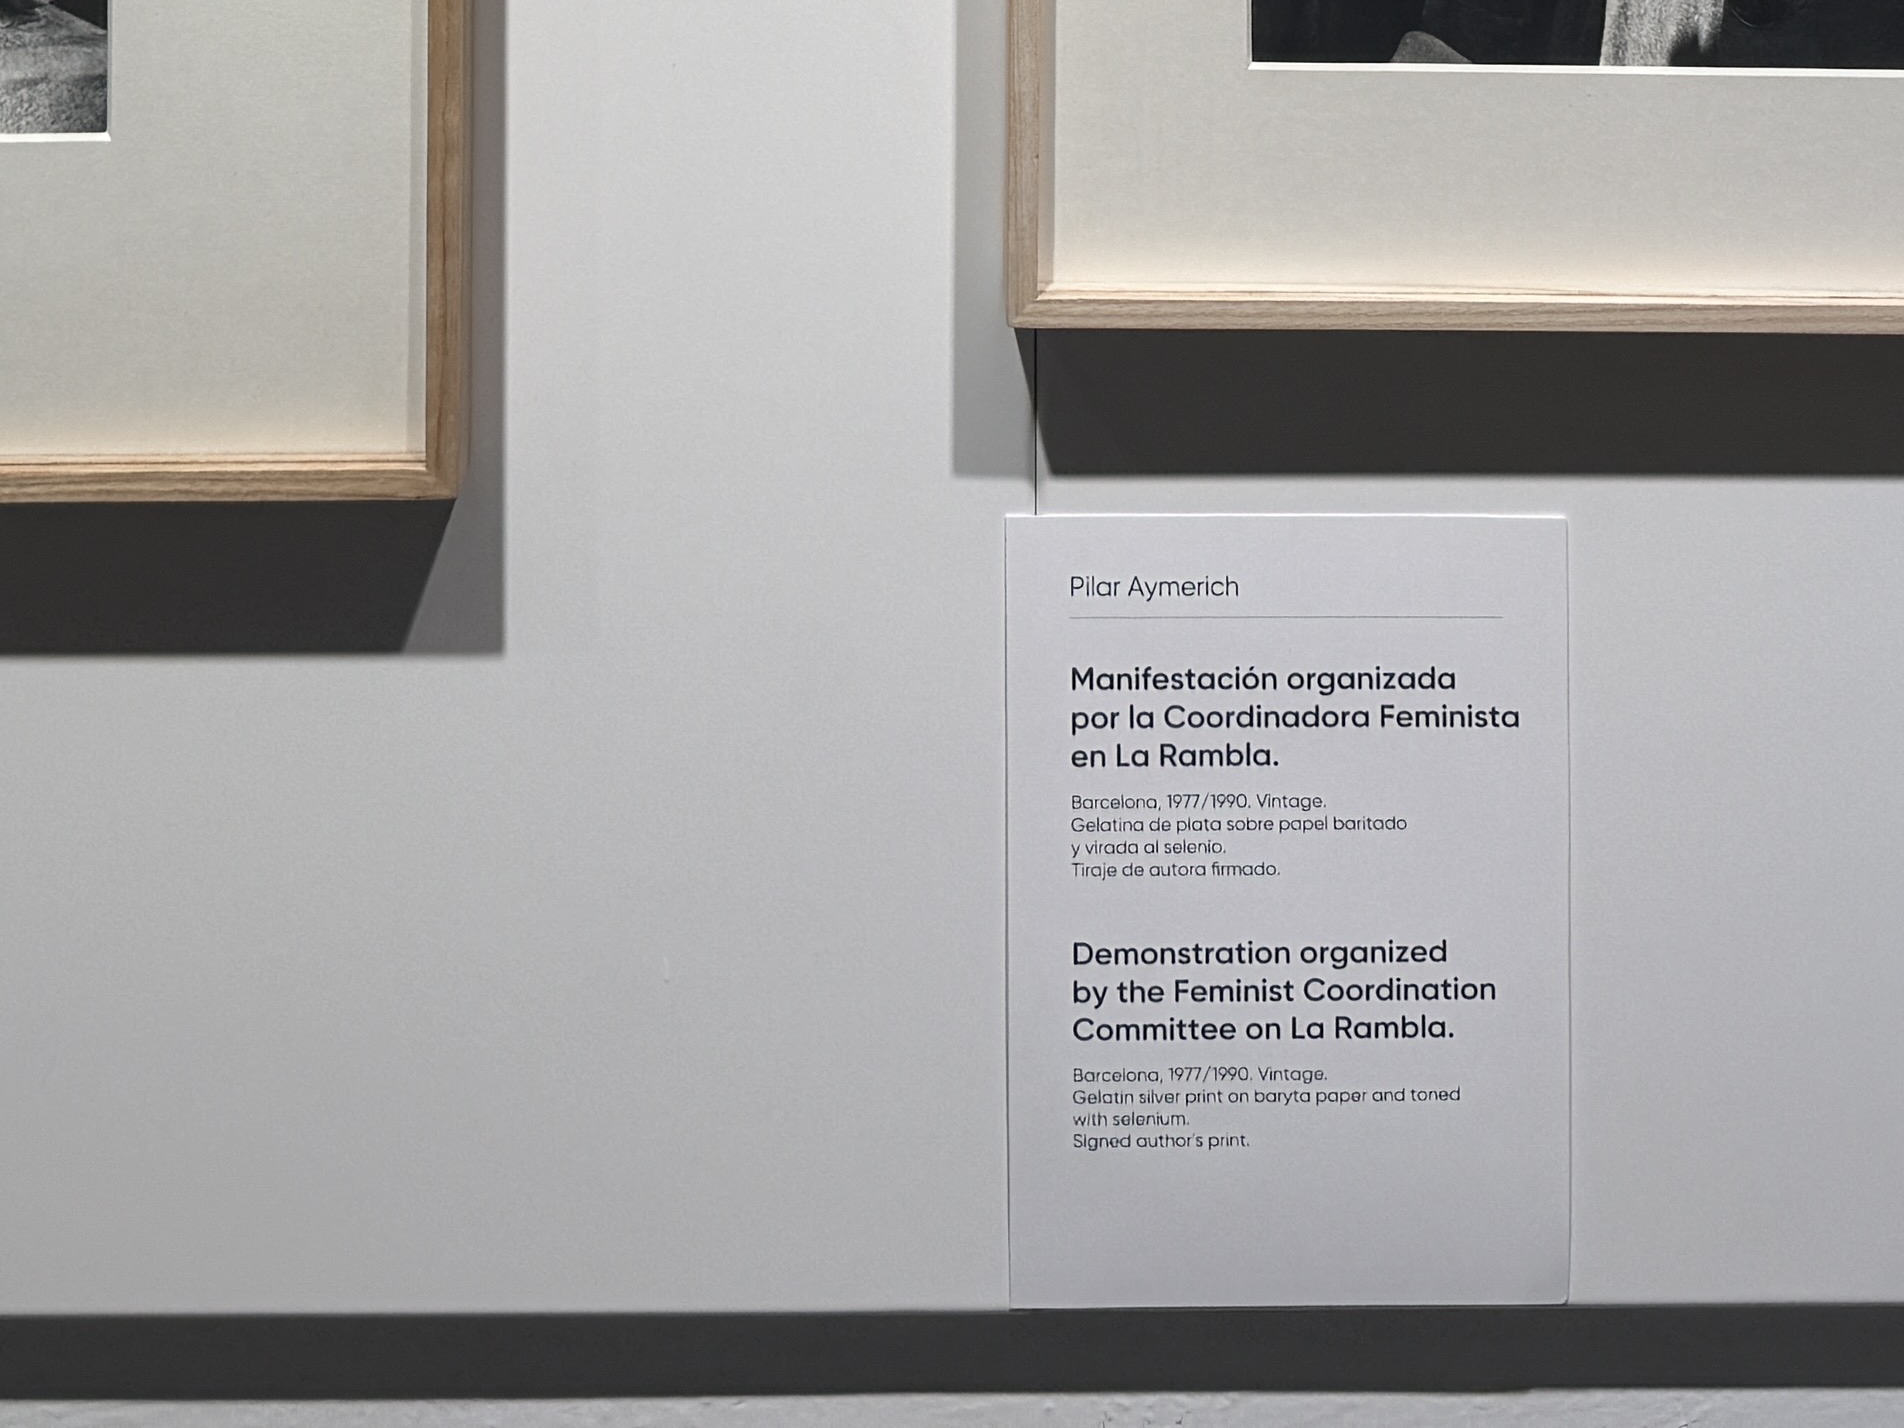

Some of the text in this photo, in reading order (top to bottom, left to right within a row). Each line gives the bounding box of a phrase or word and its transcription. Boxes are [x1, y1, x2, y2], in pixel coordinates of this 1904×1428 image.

[1071, 576, 1238, 602] Pilar Aymerich
[1072, 666, 1455, 696] Manifestación organizada
[1072, 704, 1519, 736] por la Coordinadora Feminista
[1072, 742, 1278, 768] en La Rambla.
[1072, 792, 1326, 812] Barcelona, 1977/1990. Vintage.
[1071, 815, 1407, 835] Gelatina de plata sobre papel baritado
[1071, 838, 1226, 858] y virada al selenio.
[1072, 861, 1280, 881] Tiraje de autora firmado.
[1074, 939, 1446, 969] Demonstration organized
[1074, 977, 1495, 1009] by the Feminist Coordination
[1073, 1014, 1453, 1041] Committee on La Rambla.
[1074, 1066, 1327, 1084] Barcelona, 1977/1990. Vintage.
[1073, 1087, 1460, 1106] Gelatin silver print on baryta paper and toned
[1073, 1111, 1189, 1127] with selenium.
[1074, 1134, 1249, 1151] Signed author's print.
